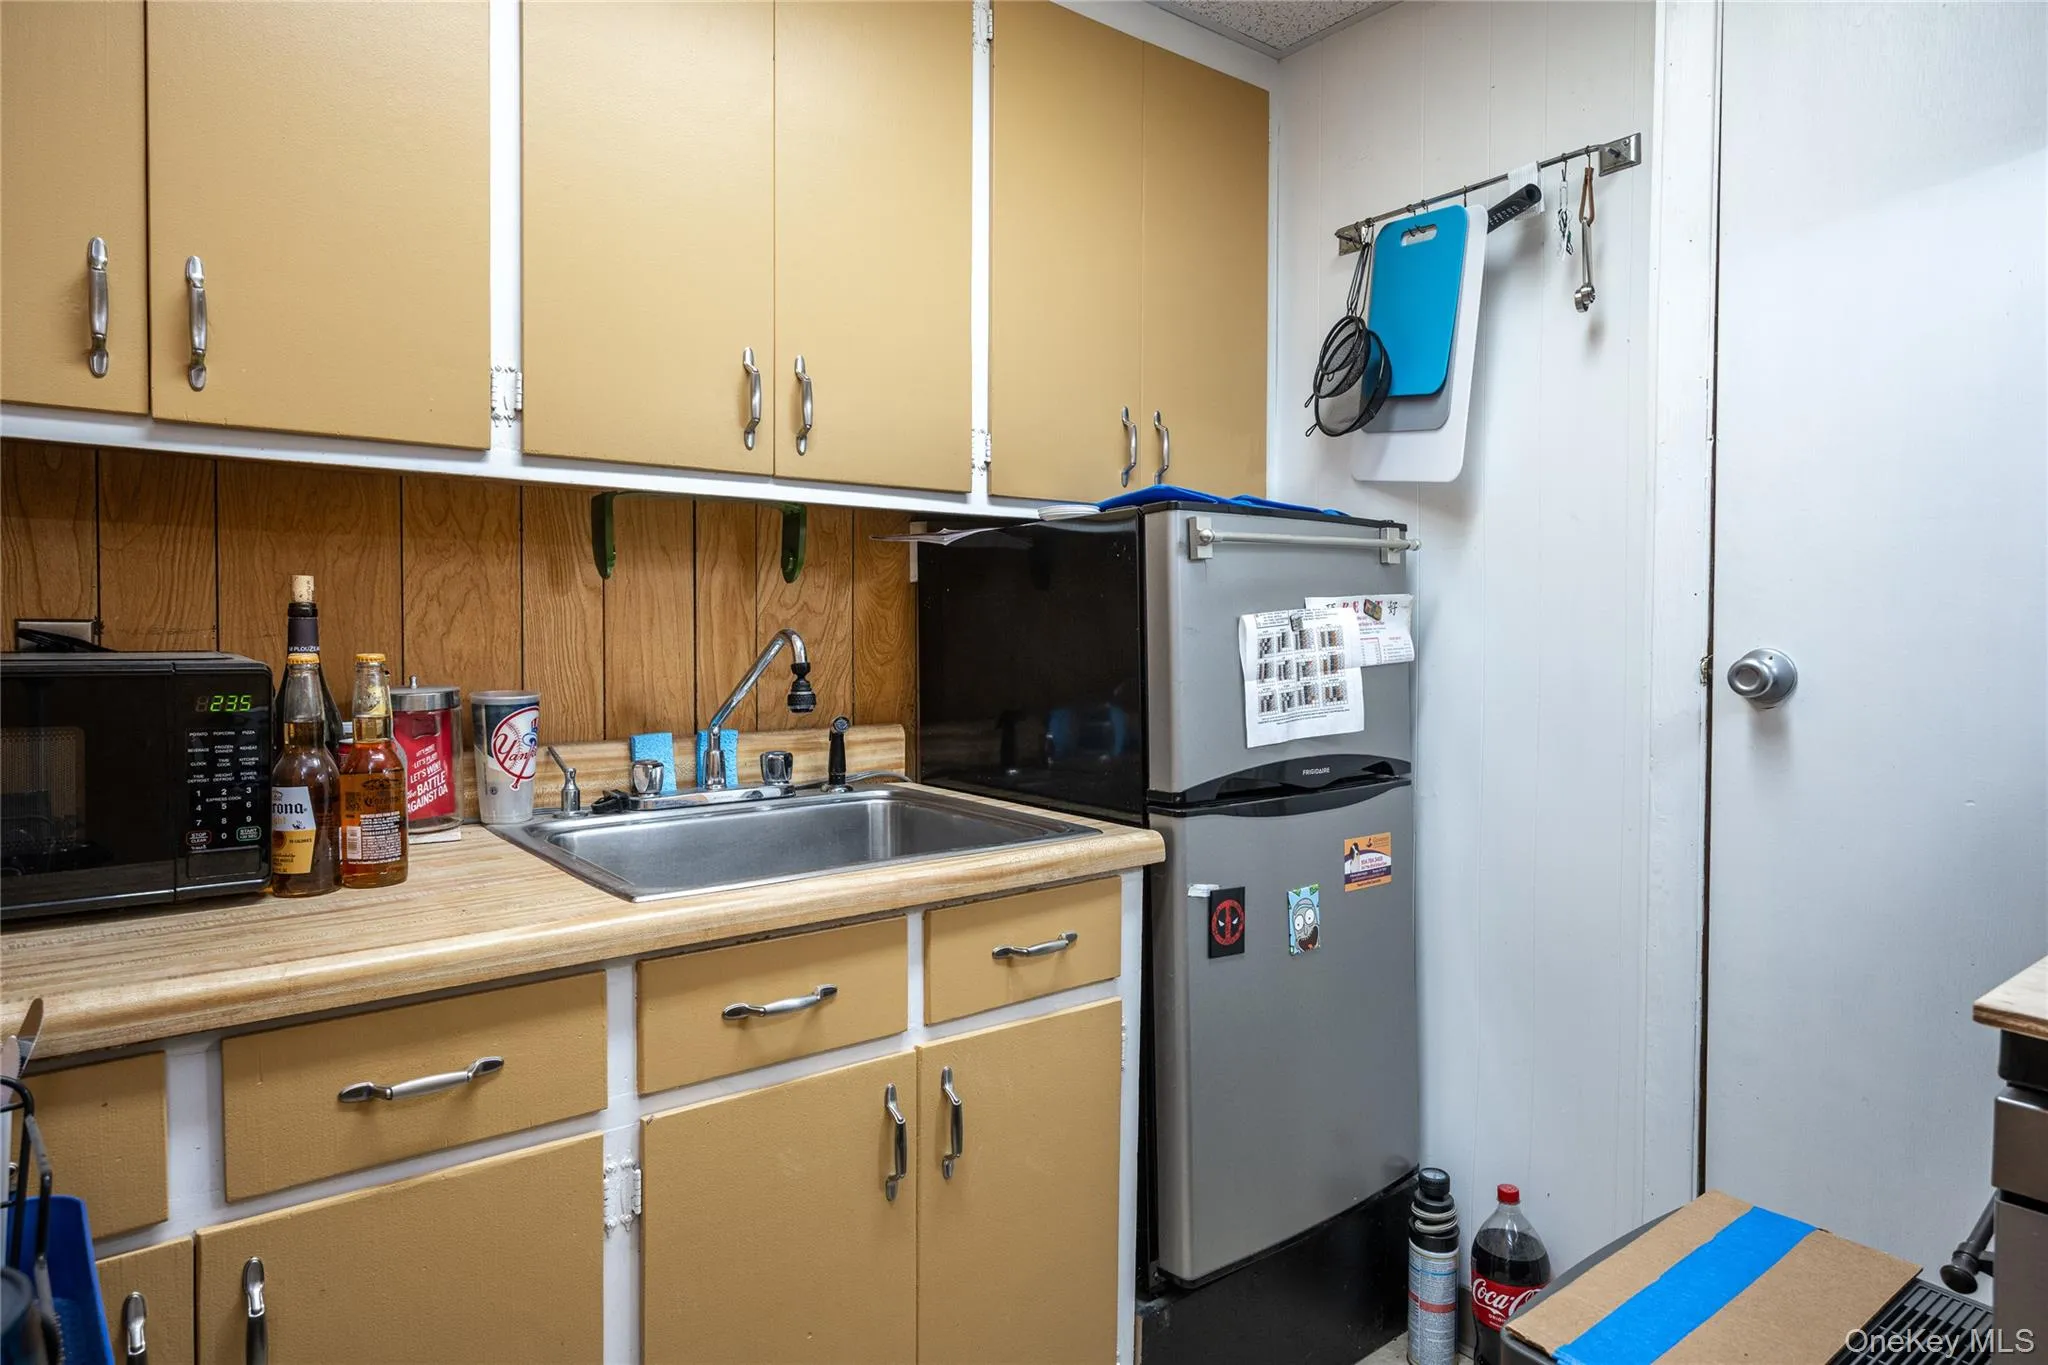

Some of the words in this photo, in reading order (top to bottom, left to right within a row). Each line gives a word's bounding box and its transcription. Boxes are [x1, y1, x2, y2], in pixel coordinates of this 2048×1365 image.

[414, 757, 426, 769] LET'S
[410, 769, 427, 784] LET'S
[427, 760, 442, 775] WIN!
[1302, 767, 1331, 776] FRIGIDAIRE
[417, 770, 447, 797] BATTLE
[221, 788, 227, 796] 2
[246, 786, 252, 794] 3
[407, 788, 438, 813] AGAINST
[195, 804, 202, 812] 4
[221, 802, 227, 810] 5
[221, 817, 227, 825] 8
[246, 815, 252, 823] 9
